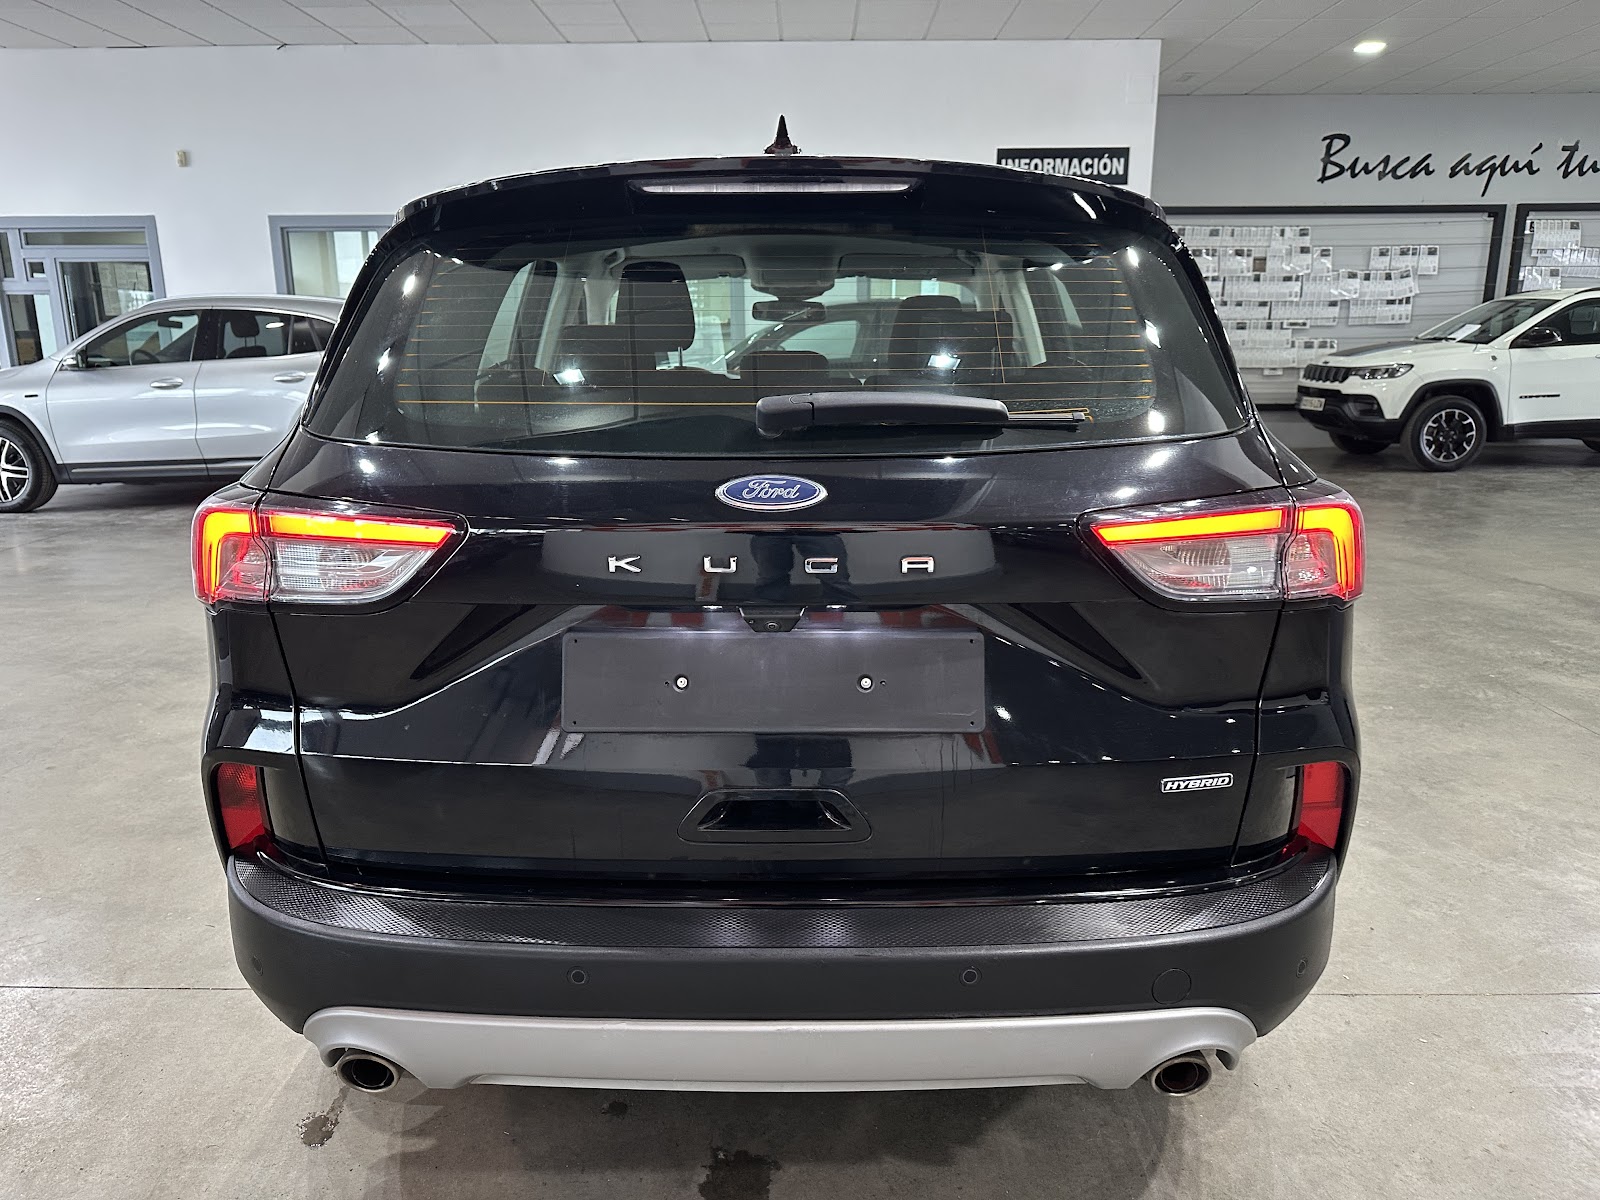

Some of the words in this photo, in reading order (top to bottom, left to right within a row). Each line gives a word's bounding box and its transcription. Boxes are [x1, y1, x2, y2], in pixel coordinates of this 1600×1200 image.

[1317, 133, 1435, 183] Busca
[1449, 142, 1541, 197] aquí
[1557, 139, 1600, 179] tu
[742, 479, 801, 499] Ford
[607, 555, 936, 574] KUGA
[1164, 776, 1230, 791] HYBRID
